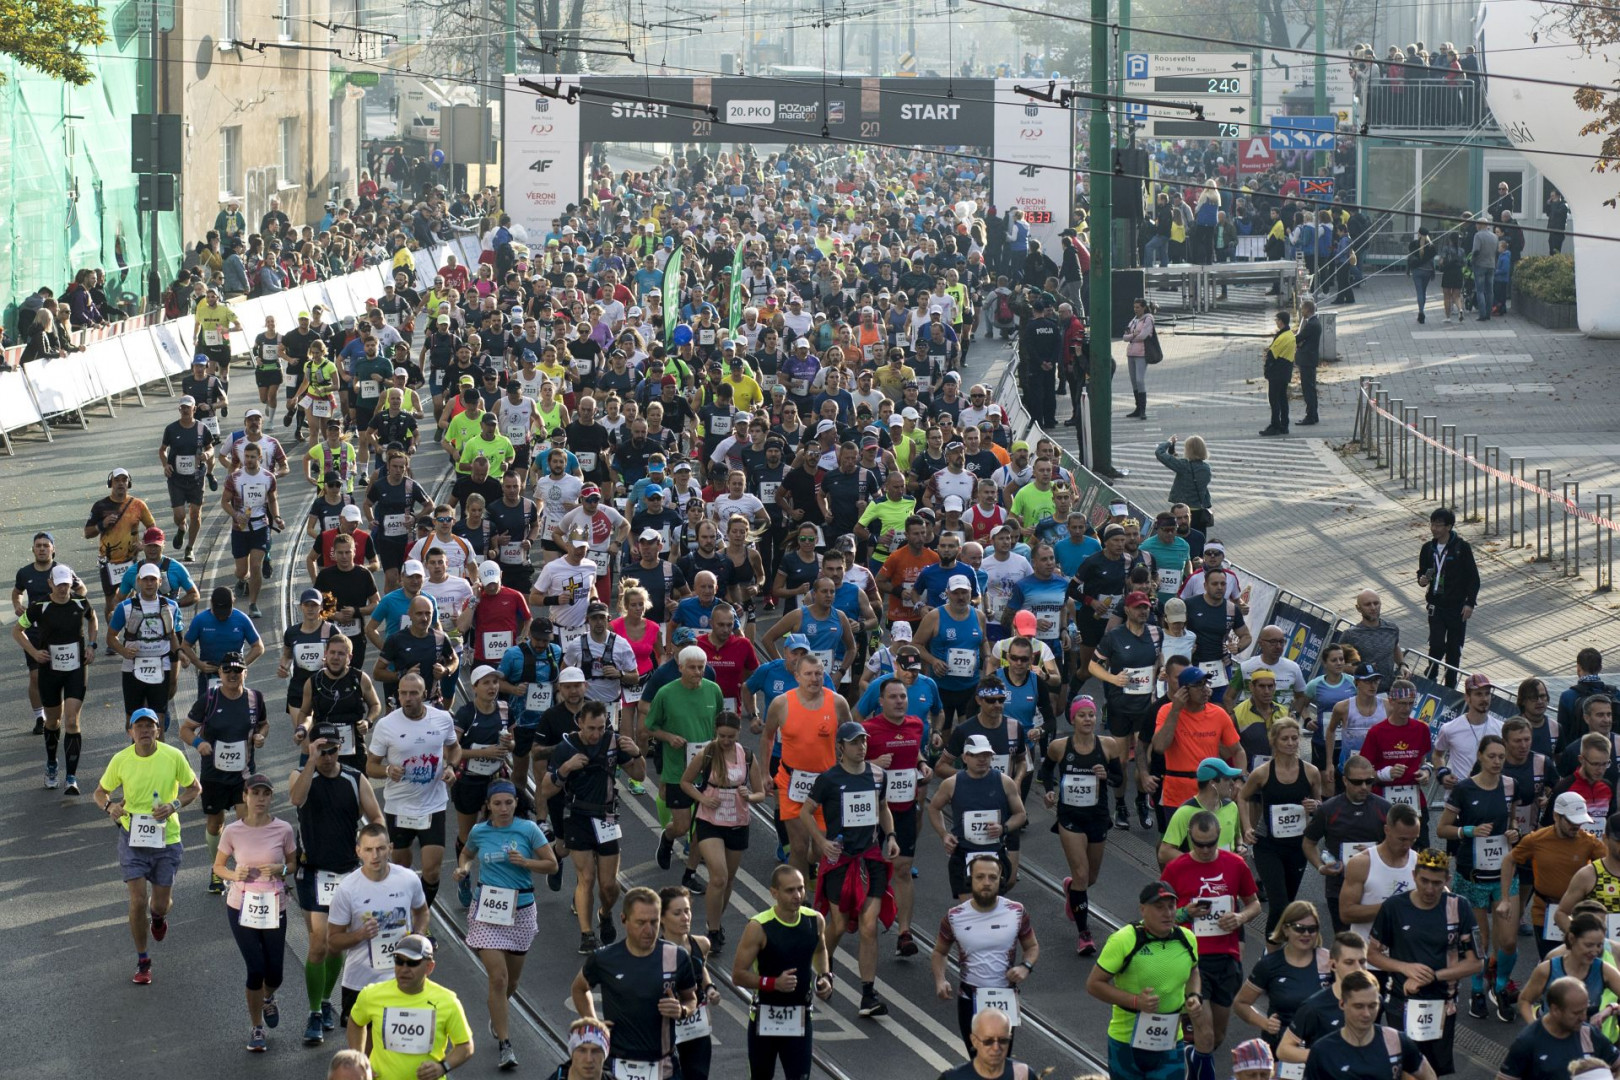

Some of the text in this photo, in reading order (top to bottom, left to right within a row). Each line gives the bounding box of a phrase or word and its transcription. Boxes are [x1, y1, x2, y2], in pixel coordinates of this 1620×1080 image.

[1154, 54, 1196, 62] Roosevelta
[1208, 79, 1240, 93] 240
[611, 102, 670, 118] START
[731, 106, 771, 117] 20. PKO
[900, 104, 960, 120] START
[1219, 123, 1239, 137] 75
[1246, 138, 1269, 158] A
[529, 160, 553, 172] 4F
[526, 191, 556, 199] VERONI
[1016, 196, 1046, 205] VERONI
[488, 640, 508, 648] 6966
[55, 652, 75, 661] 4234
[300, 652, 319, 662] 6759
[140, 666, 156, 674] 1772
[219, 752, 241, 760] 4792
[890, 780, 913, 789] 2854
[1068, 786, 1091, 794] 3433
[849, 803, 871, 813] 1888
[1278, 815, 1301, 825] 5827
[138, 824, 156, 834] 708
[971, 822, 989, 832] 572
[1484, 847, 1503, 857] 1741
[248, 905, 269, 914] 5732
[483, 898, 508, 911] 4865
[768, 1010, 793, 1020] 3411
[1417, 1014, 1433, 1024] 415
[391, 1024, 424, 1036] 7060
[1146, 1027, 1168, 1037] 684
